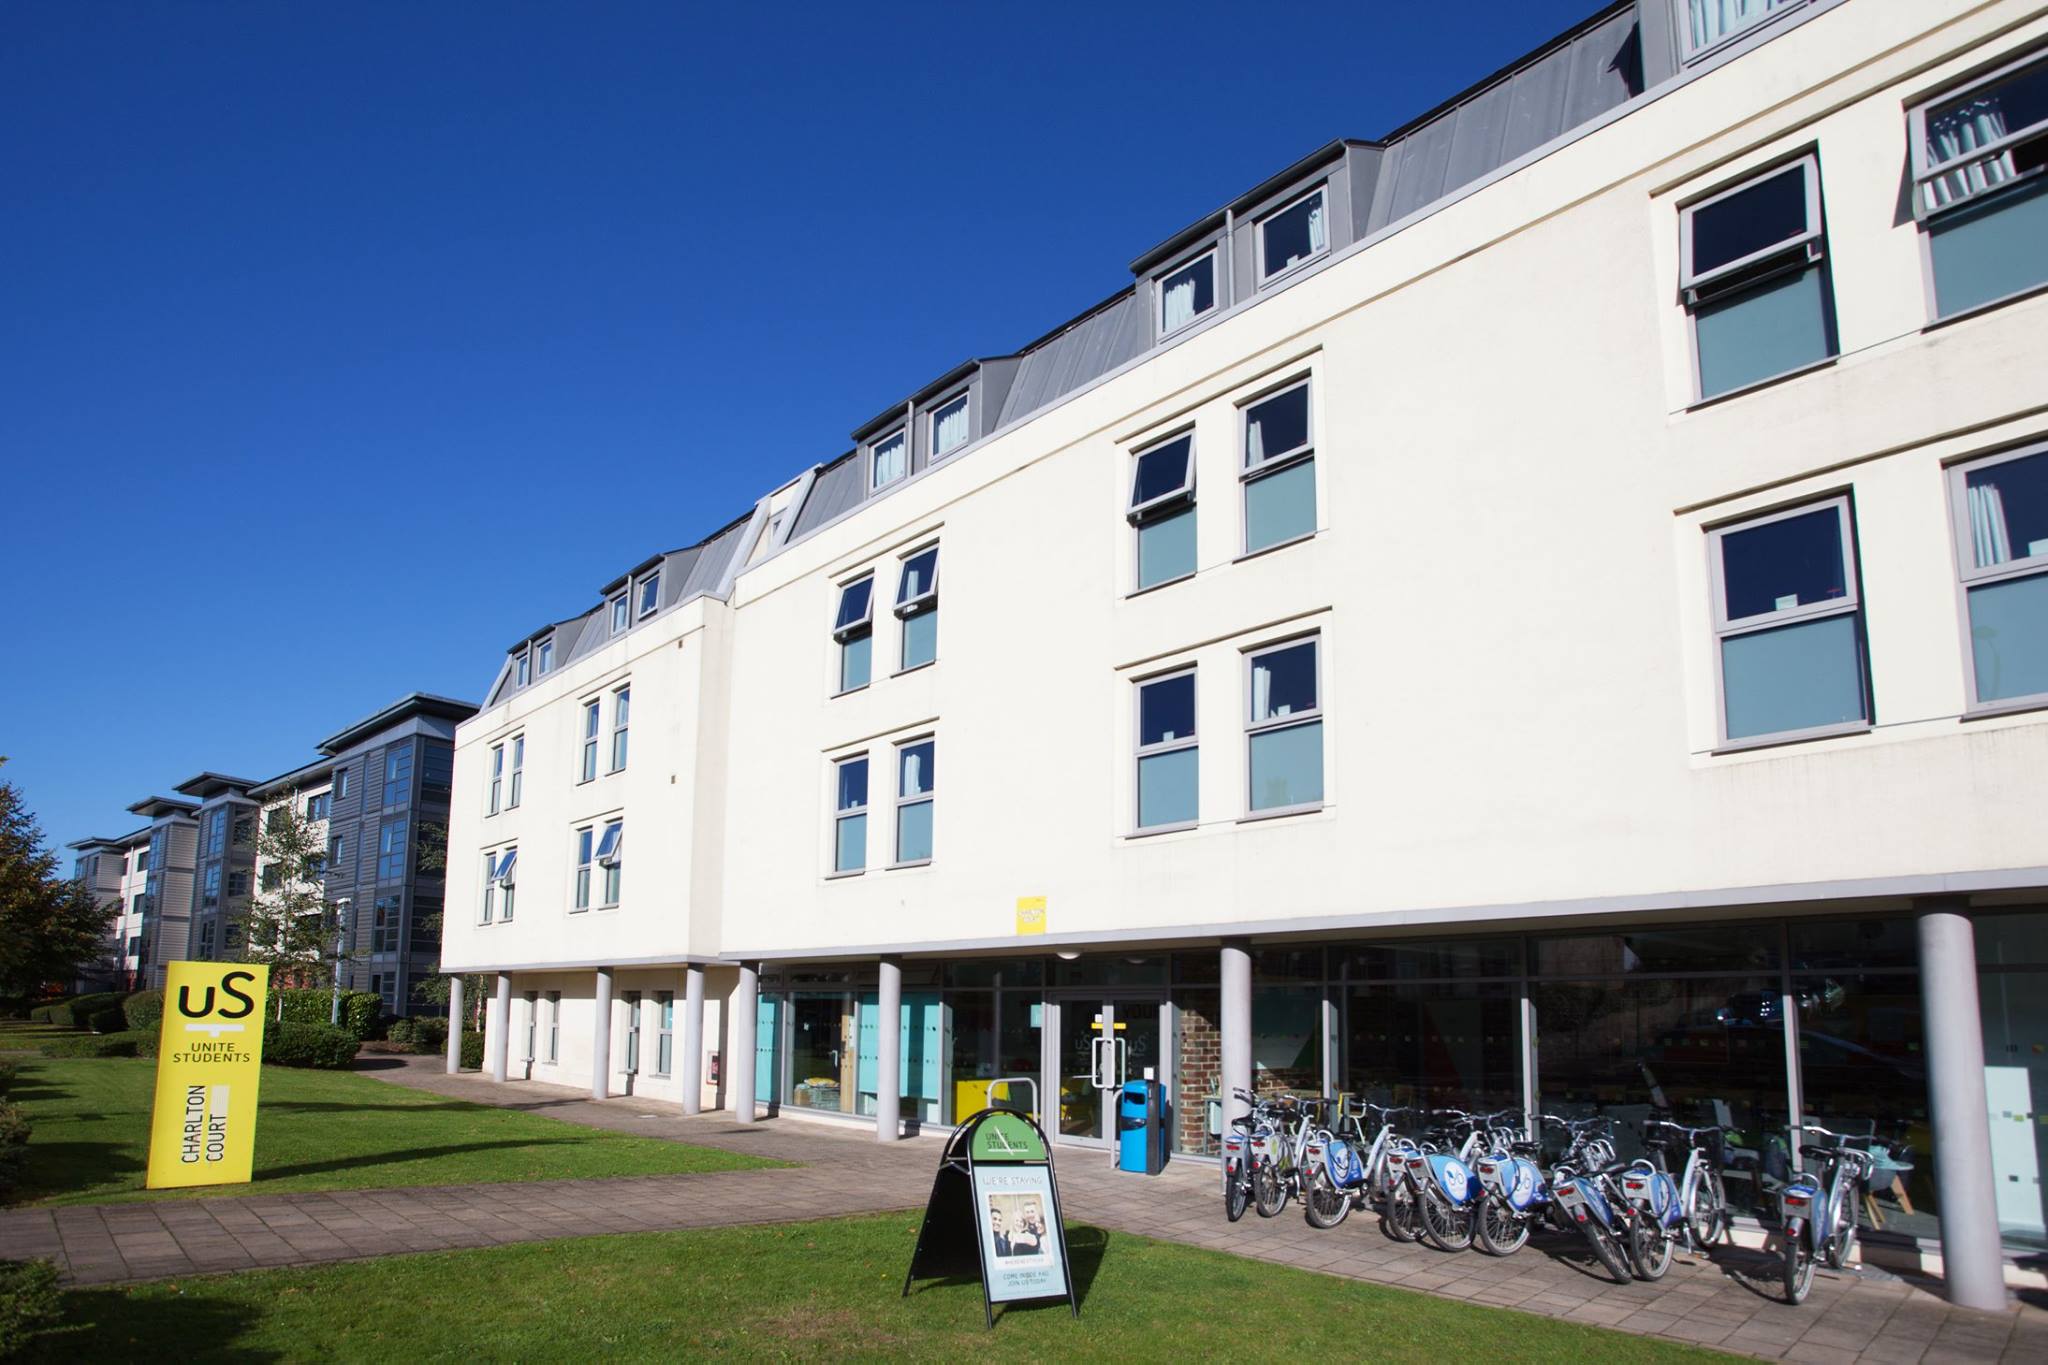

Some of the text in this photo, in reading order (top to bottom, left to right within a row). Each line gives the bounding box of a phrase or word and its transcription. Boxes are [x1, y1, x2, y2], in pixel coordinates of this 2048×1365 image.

[191, 1042, 236, 1052] UNITE
[173, 1052, 251, 1063] STUDENTS
[181, 1085, 206, 1164] CHARLTON
[206, 1114, 227, 1163] COURT
[1011, 1175, 1042, 1185] STAYING
